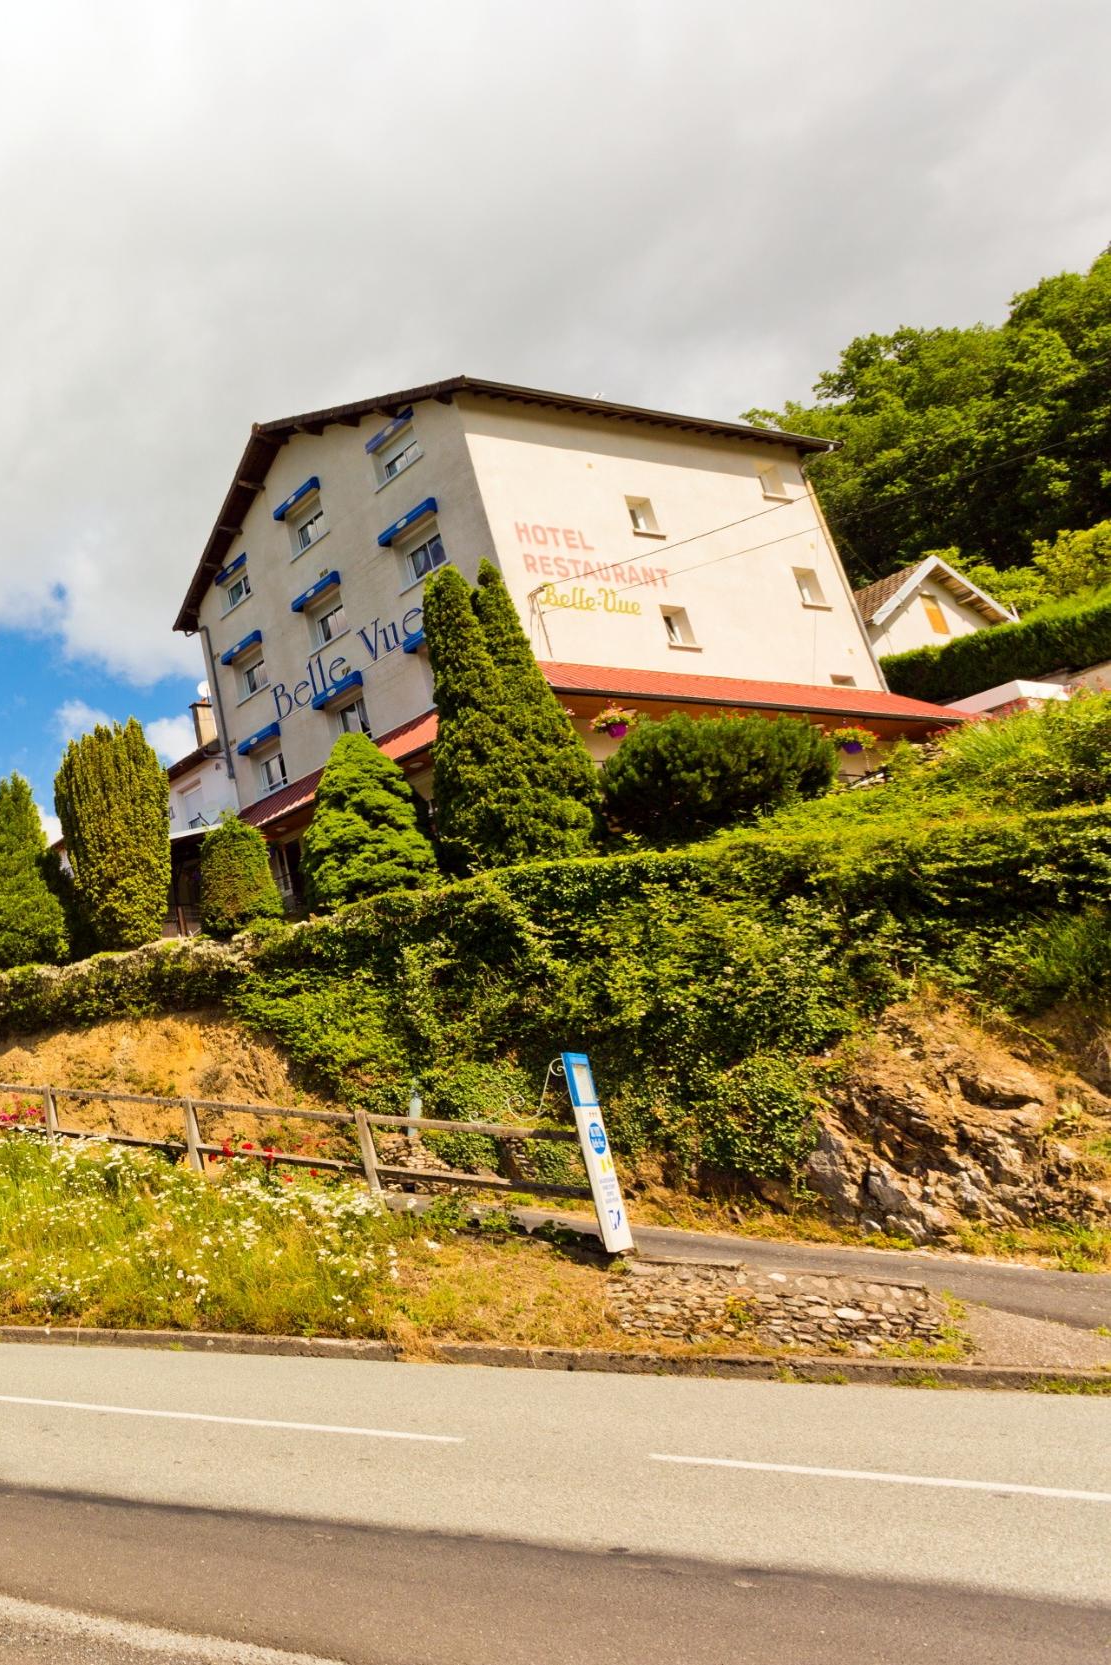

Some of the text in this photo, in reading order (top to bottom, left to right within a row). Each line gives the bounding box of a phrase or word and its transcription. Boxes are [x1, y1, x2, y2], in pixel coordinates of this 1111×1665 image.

[514, 521, 595, 551] HOTEL
[522, 552, 669, 589] RESTAURANT
[270, 607, 424, 721] Belle Vue
